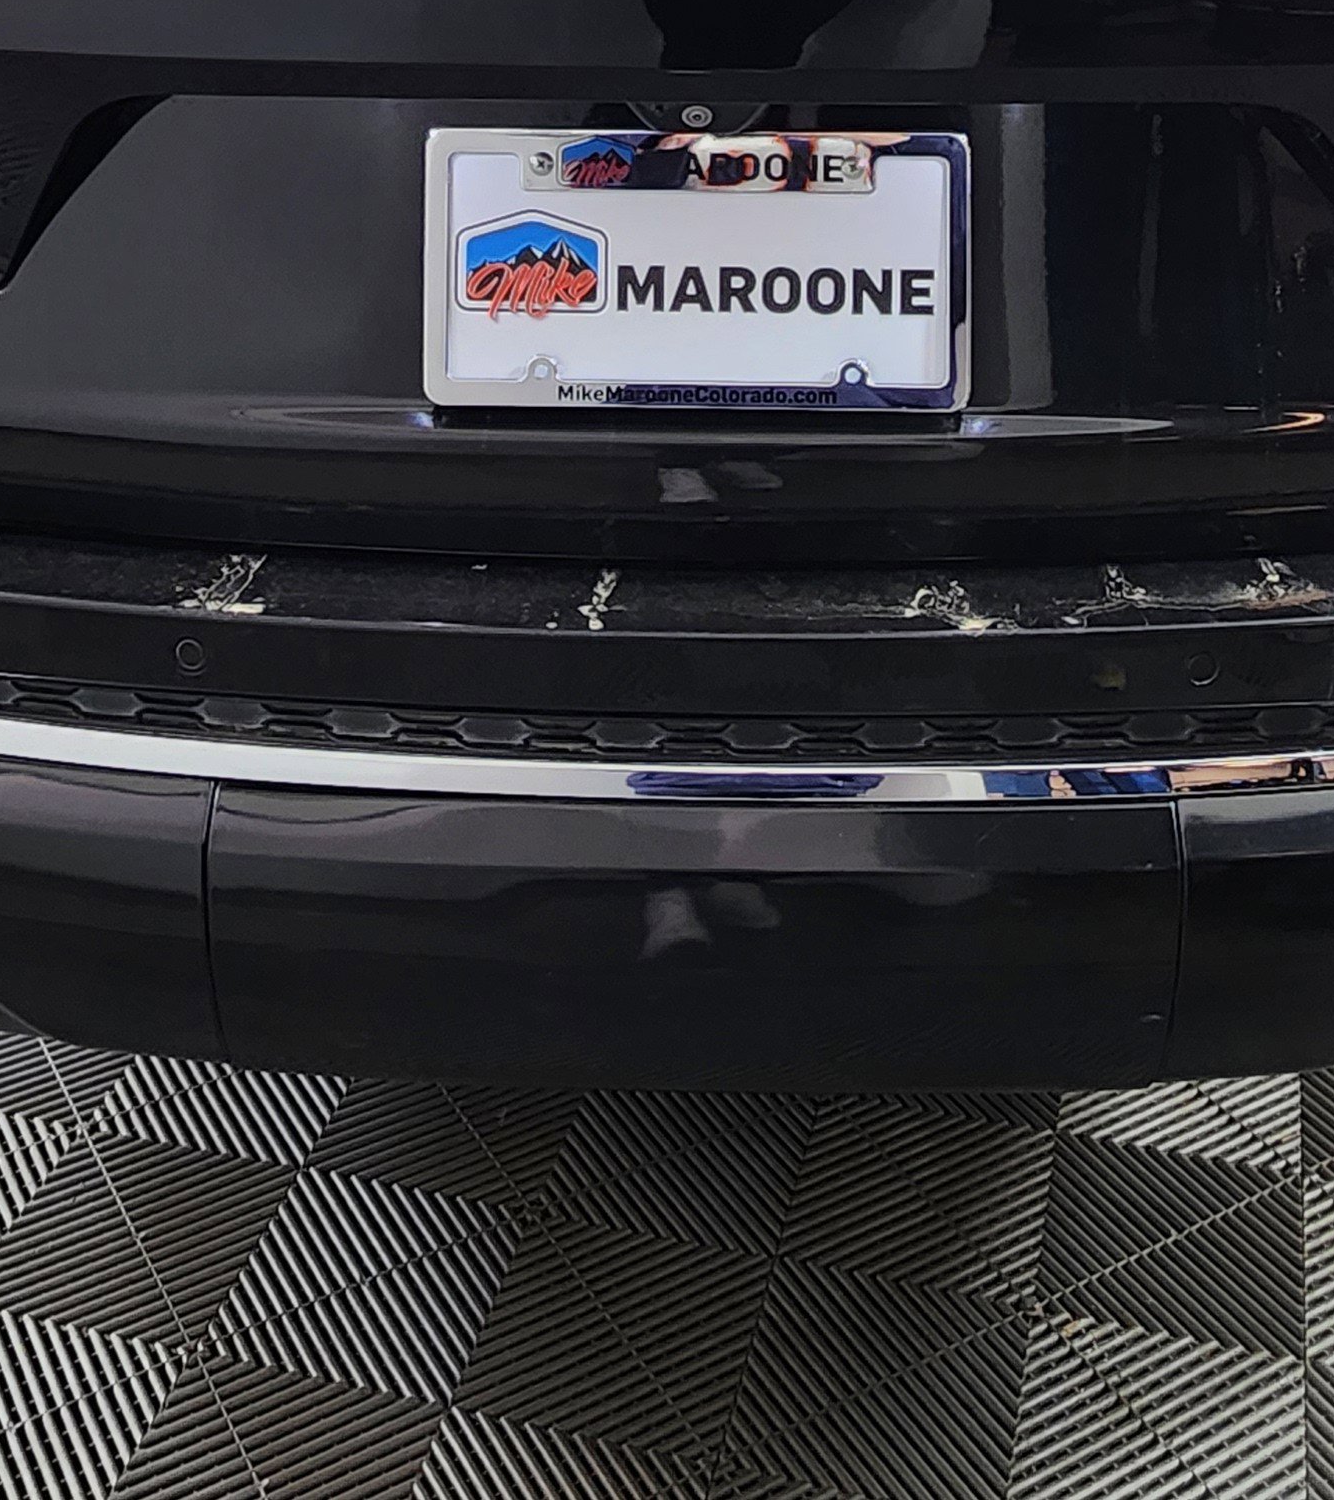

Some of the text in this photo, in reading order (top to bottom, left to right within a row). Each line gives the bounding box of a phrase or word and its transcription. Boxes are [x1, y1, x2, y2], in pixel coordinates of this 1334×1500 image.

[467, 258, 935, 323] Mike MAROONE
[557, 384, 837, 405] MikeMarooneColorado.com
